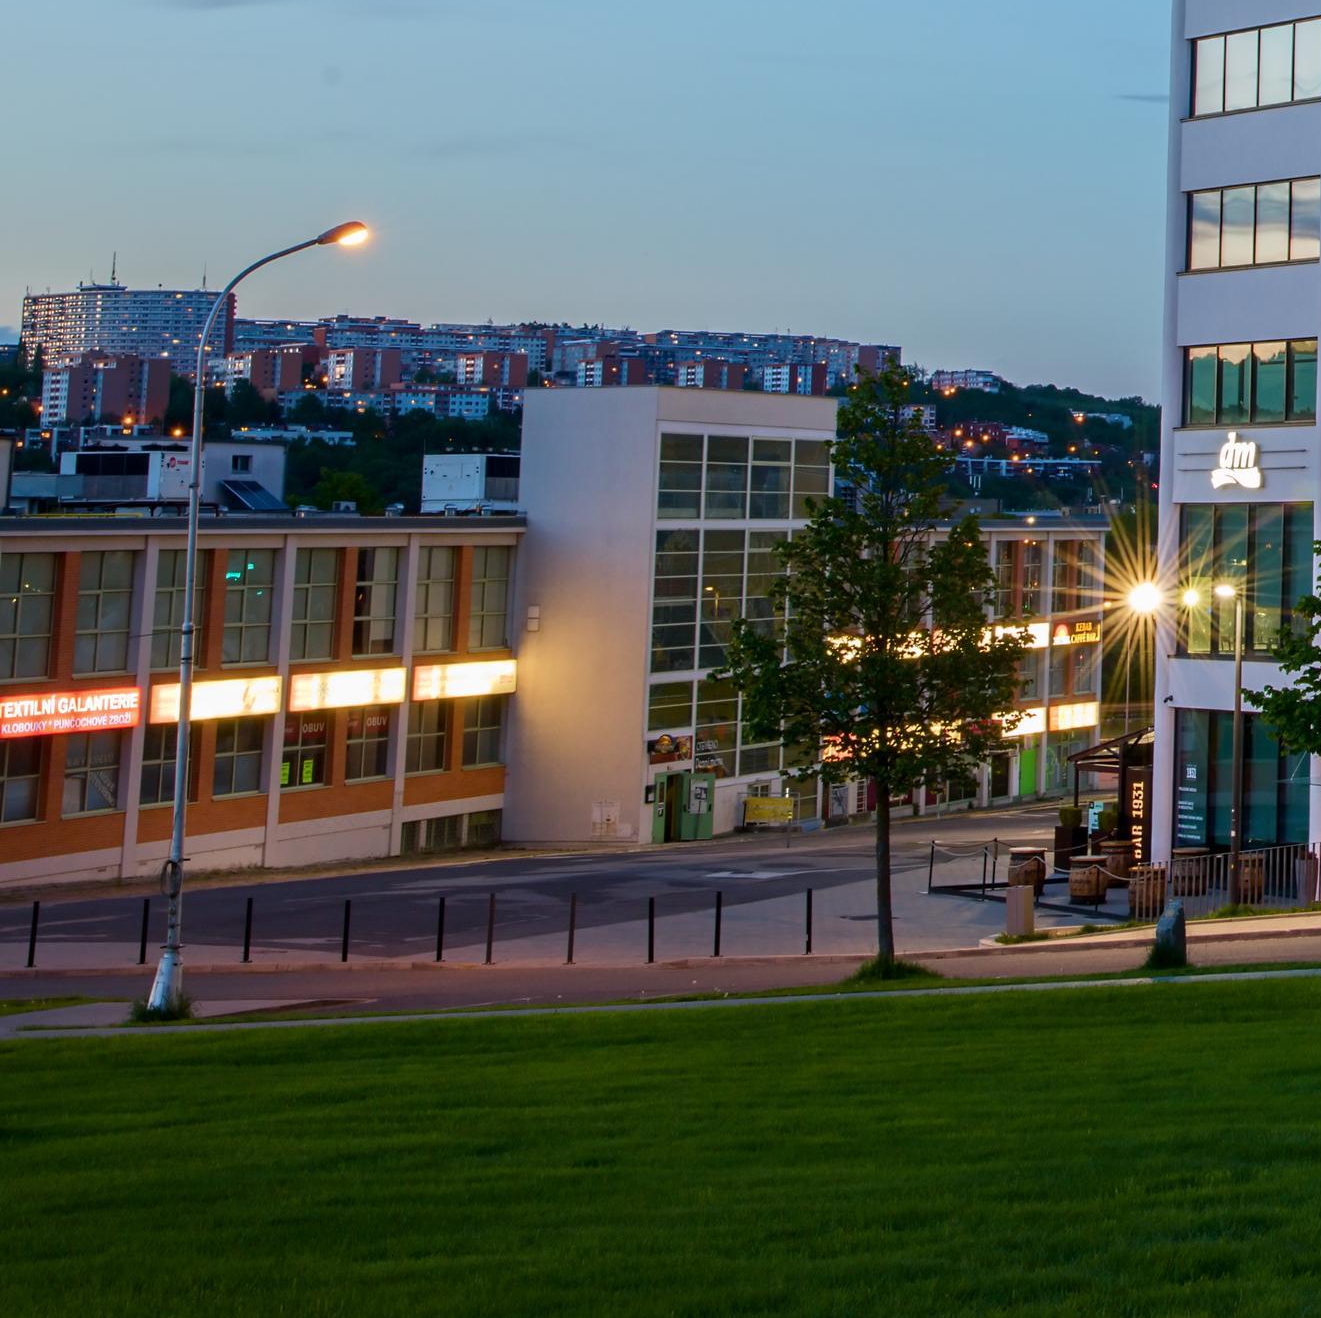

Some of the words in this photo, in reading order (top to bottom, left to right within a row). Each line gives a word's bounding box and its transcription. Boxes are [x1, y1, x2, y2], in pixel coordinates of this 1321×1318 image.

[0, 695, 56, 719] TEXTILNÍ
[57, 692, 139, 714] GALANTERIE
[1, 721, 46, 734] KLOBOUKY
[302, 722, 325, 733] OBUV
[366, 716, 388, 727] OBUV
[1132, 781, 1144, 819] 1931
